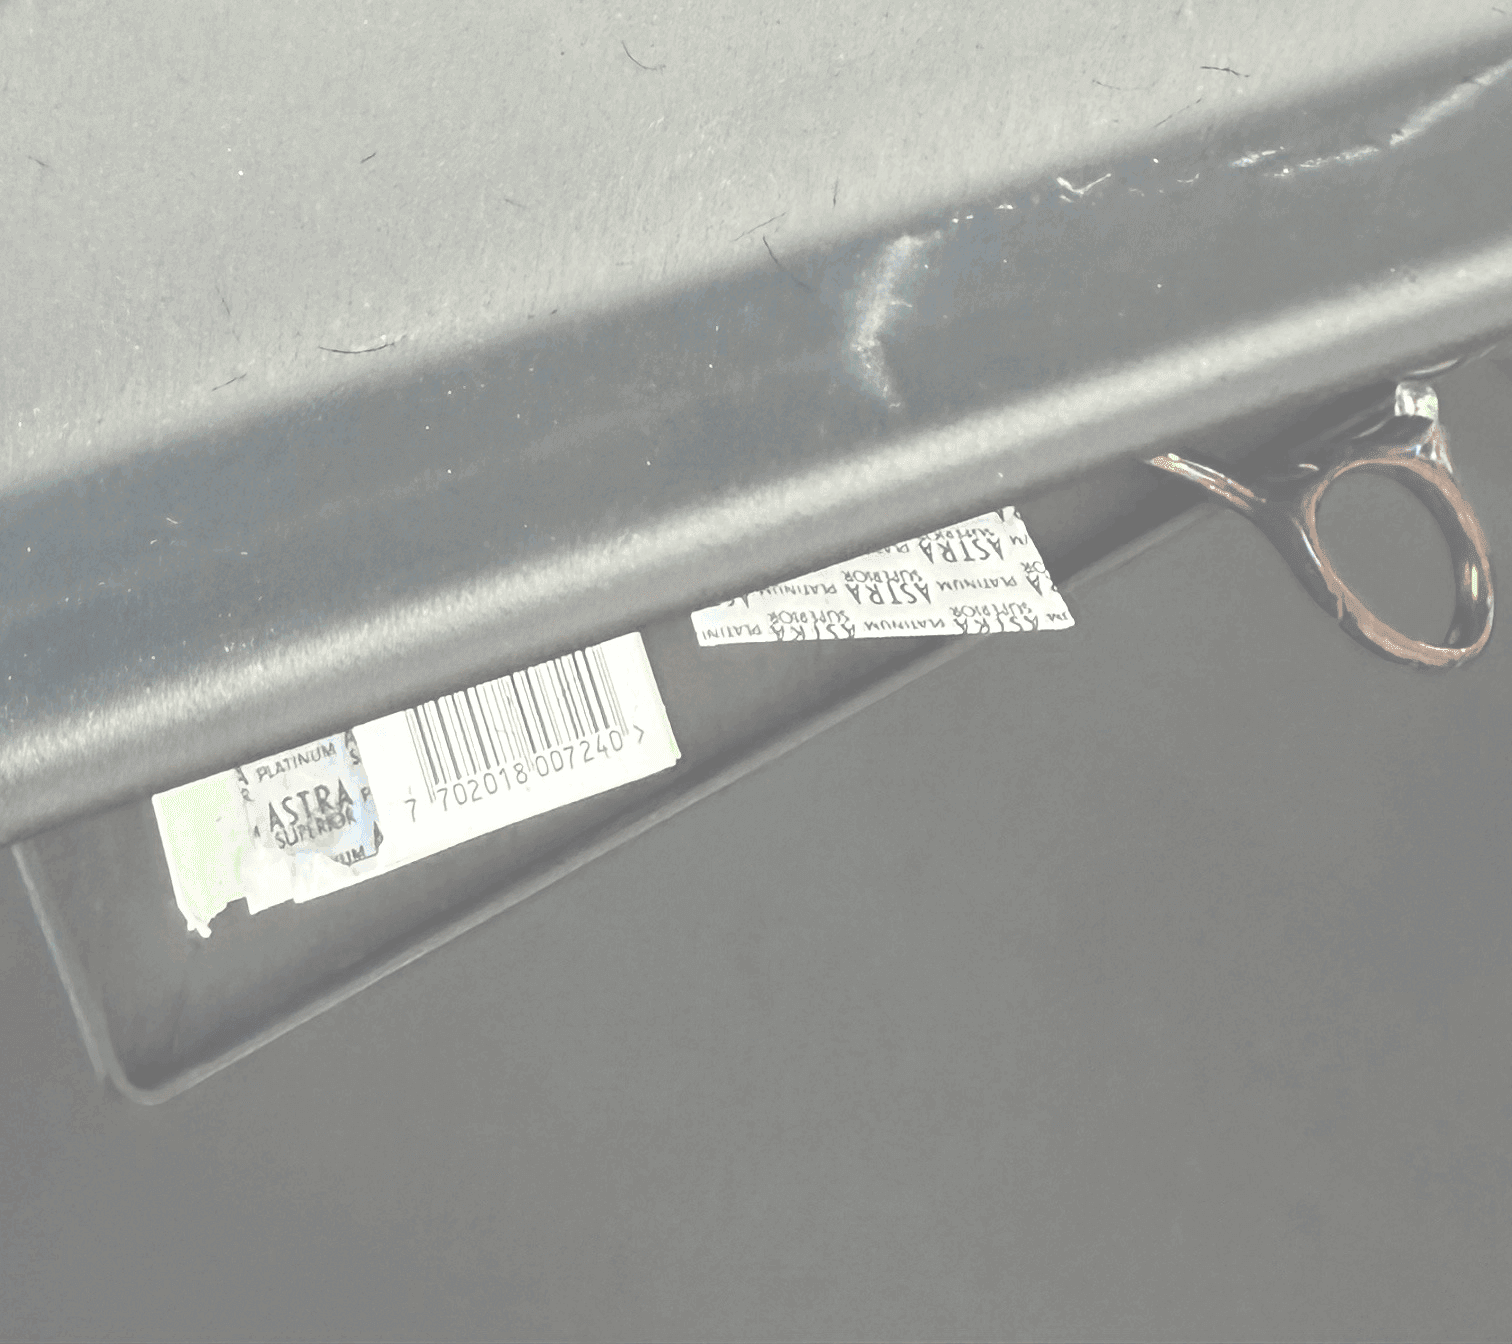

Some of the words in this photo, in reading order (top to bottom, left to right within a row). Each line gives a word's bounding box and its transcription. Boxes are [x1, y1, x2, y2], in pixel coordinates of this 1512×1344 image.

[918, 538, 1003, 564] ASTRA
[844, 582, 931, 605] ASTRA
[256, 742, 337, 783] PLATINUM
[404, 797, 418, 823] 7
[436, 761, 529, 812] 702018
[535, 728, 624, 777] 007240
[268, 778, 354, 832] ASTRA
[275, 806, 357, 850] SUPERIOR
